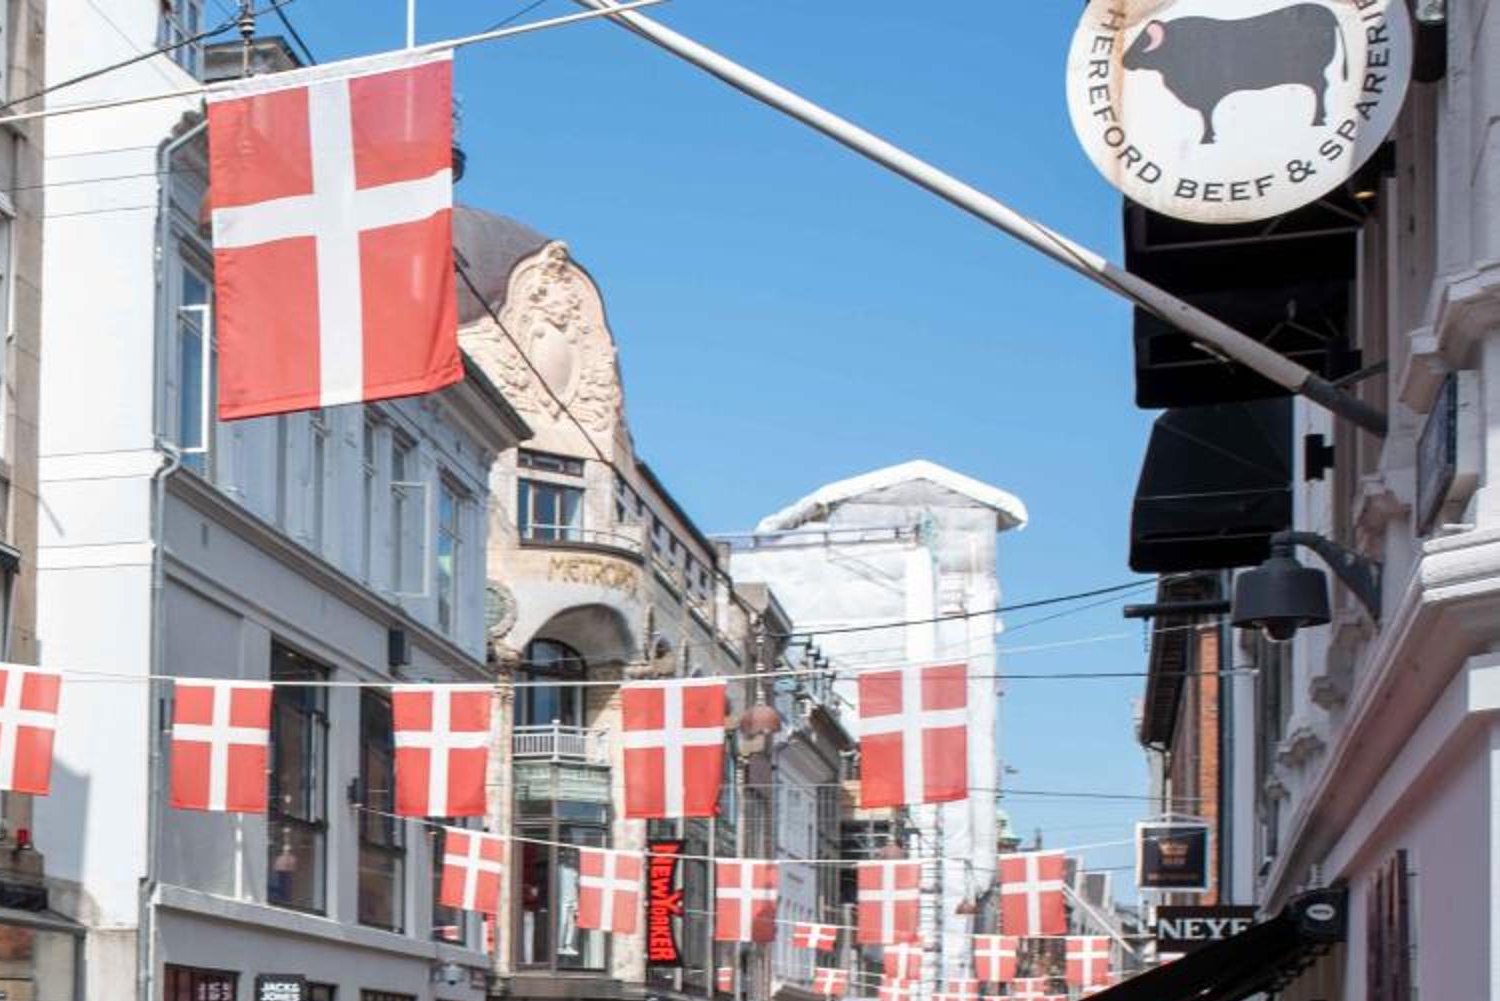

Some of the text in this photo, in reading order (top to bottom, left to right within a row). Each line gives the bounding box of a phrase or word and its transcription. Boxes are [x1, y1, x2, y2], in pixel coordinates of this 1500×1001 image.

[1088, 8, 1162, 185] HEREFORD
[1174, 174, 1277, 203] BEEF
[1286, 158, 1317, 184] &
